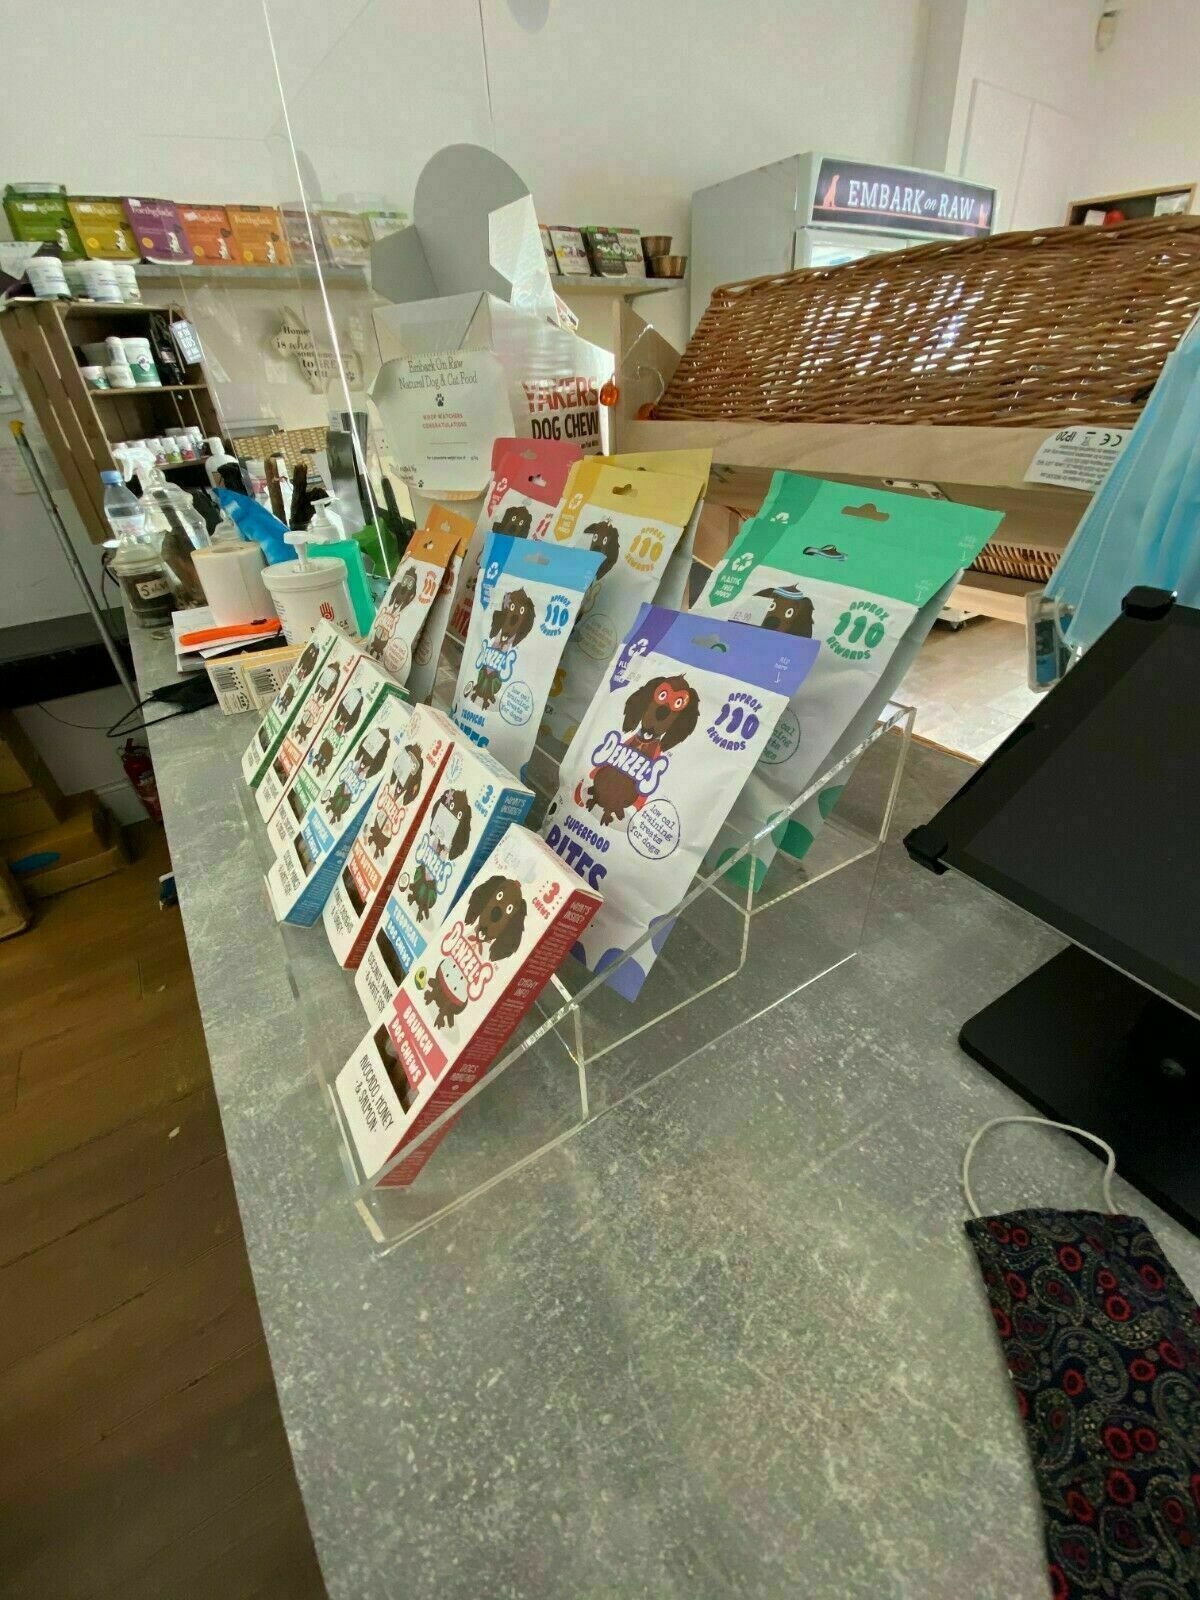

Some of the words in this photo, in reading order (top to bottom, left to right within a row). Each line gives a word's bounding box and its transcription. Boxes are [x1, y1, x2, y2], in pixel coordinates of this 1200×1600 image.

[847, 180, 925, 214] EMBARK
[924, 198, 937, 211] on
[937, 194, 975, 220] RAW
[282, 326, 310, 336] Home
[407, 359, 436, 373] Embark
[436, 358, 448, 371] On
[448, 356, 463, 370] Raw
[425, 375, 440, 390] Dog
[440, 374, 446, 387] &
[447, 373, 460, 386] Cat
[460, 371, 478, 385] Food
[531, 416, 561, 441] DOG
[1055, 431, 1077, 443] IP20
[630, 535, 663, 562] 110
[551, 595, 571, 607] APPROX
[849, 601, 889, 621] APPROX
[545, 604, 569, 627] 110
[834, 612, 885, 648] 110
[826, 636, 871, 660] REWARDS
[728, 692, 763, 713] APPROX
[462, 709, 486, 727] TROPICAL
[714, 703, 759, 740] 110
[706, 726, 746, 751] REWARDS
[482, 785, 494, 804] 3
[642, 811, 673, 842] training
[651, 804, 662, 819] low
[662, 816, 675, 830] cal
[564, 815, 610, 853] SUPERFOOD
[630, 825, 643, 839] for
[643, 837, 661, 855] dogs
[640, 821, 663, 845] treats
[543, 882, 559, 904] 3
[532, 897, 550, 919] CHEWS
[393, 905, 419, 947] TROPICAL
[387, 920, 397, 939] DOG
[395, 936, 411, 967] CHEWS
[403, 1005, 434, 1056] BRUNCH
[391, 1018, 405, 1044] DOG
[400, 1040, 421, 1082] CHEWS
[375, 1094, 394, 1131] HONEY
